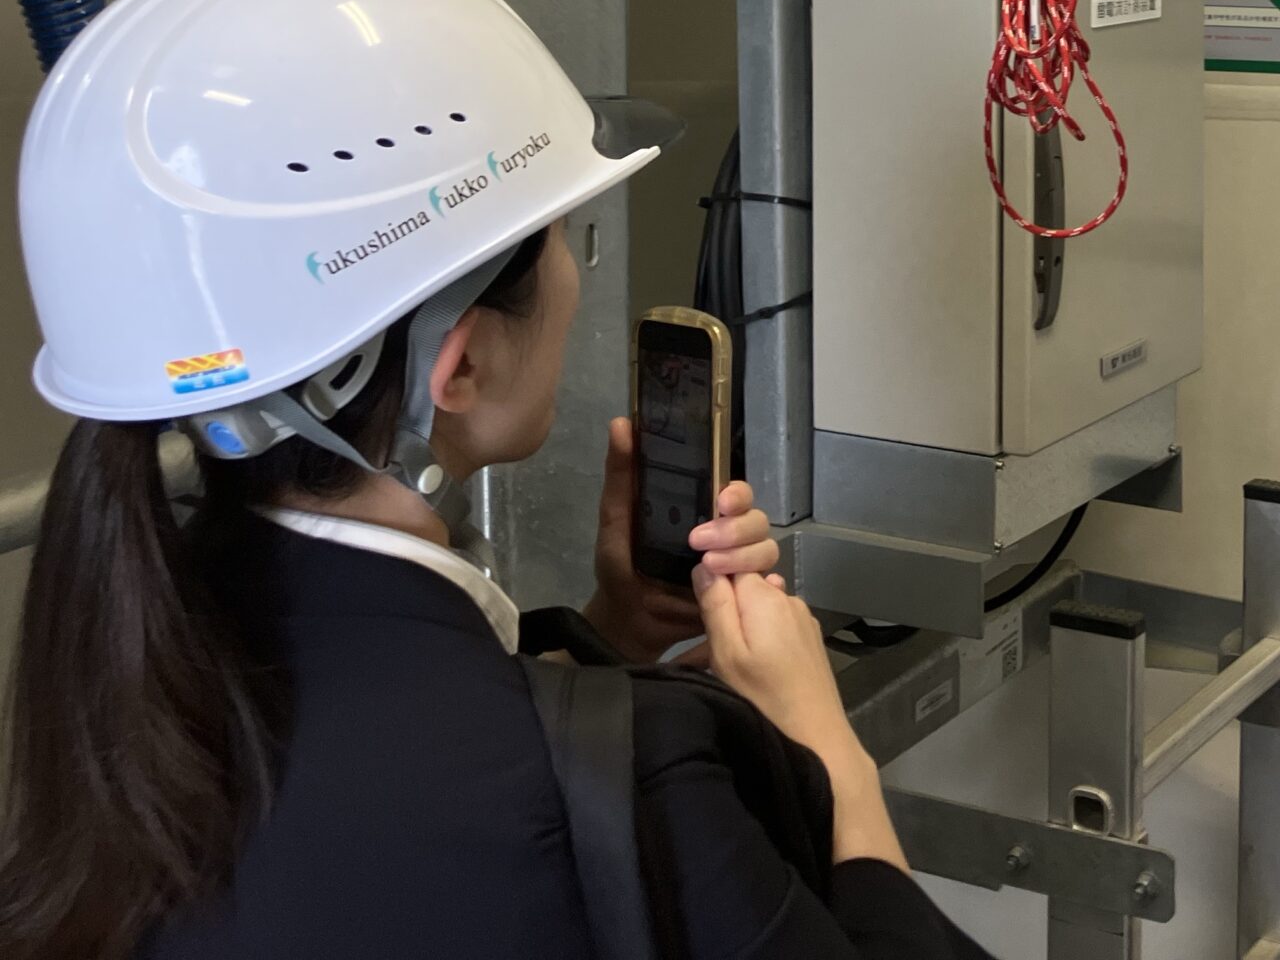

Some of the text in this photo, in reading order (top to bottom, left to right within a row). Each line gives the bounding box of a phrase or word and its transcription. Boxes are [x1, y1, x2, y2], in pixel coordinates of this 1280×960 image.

[306, 132, 552, 285] Fukushima Fukko Furyoku
